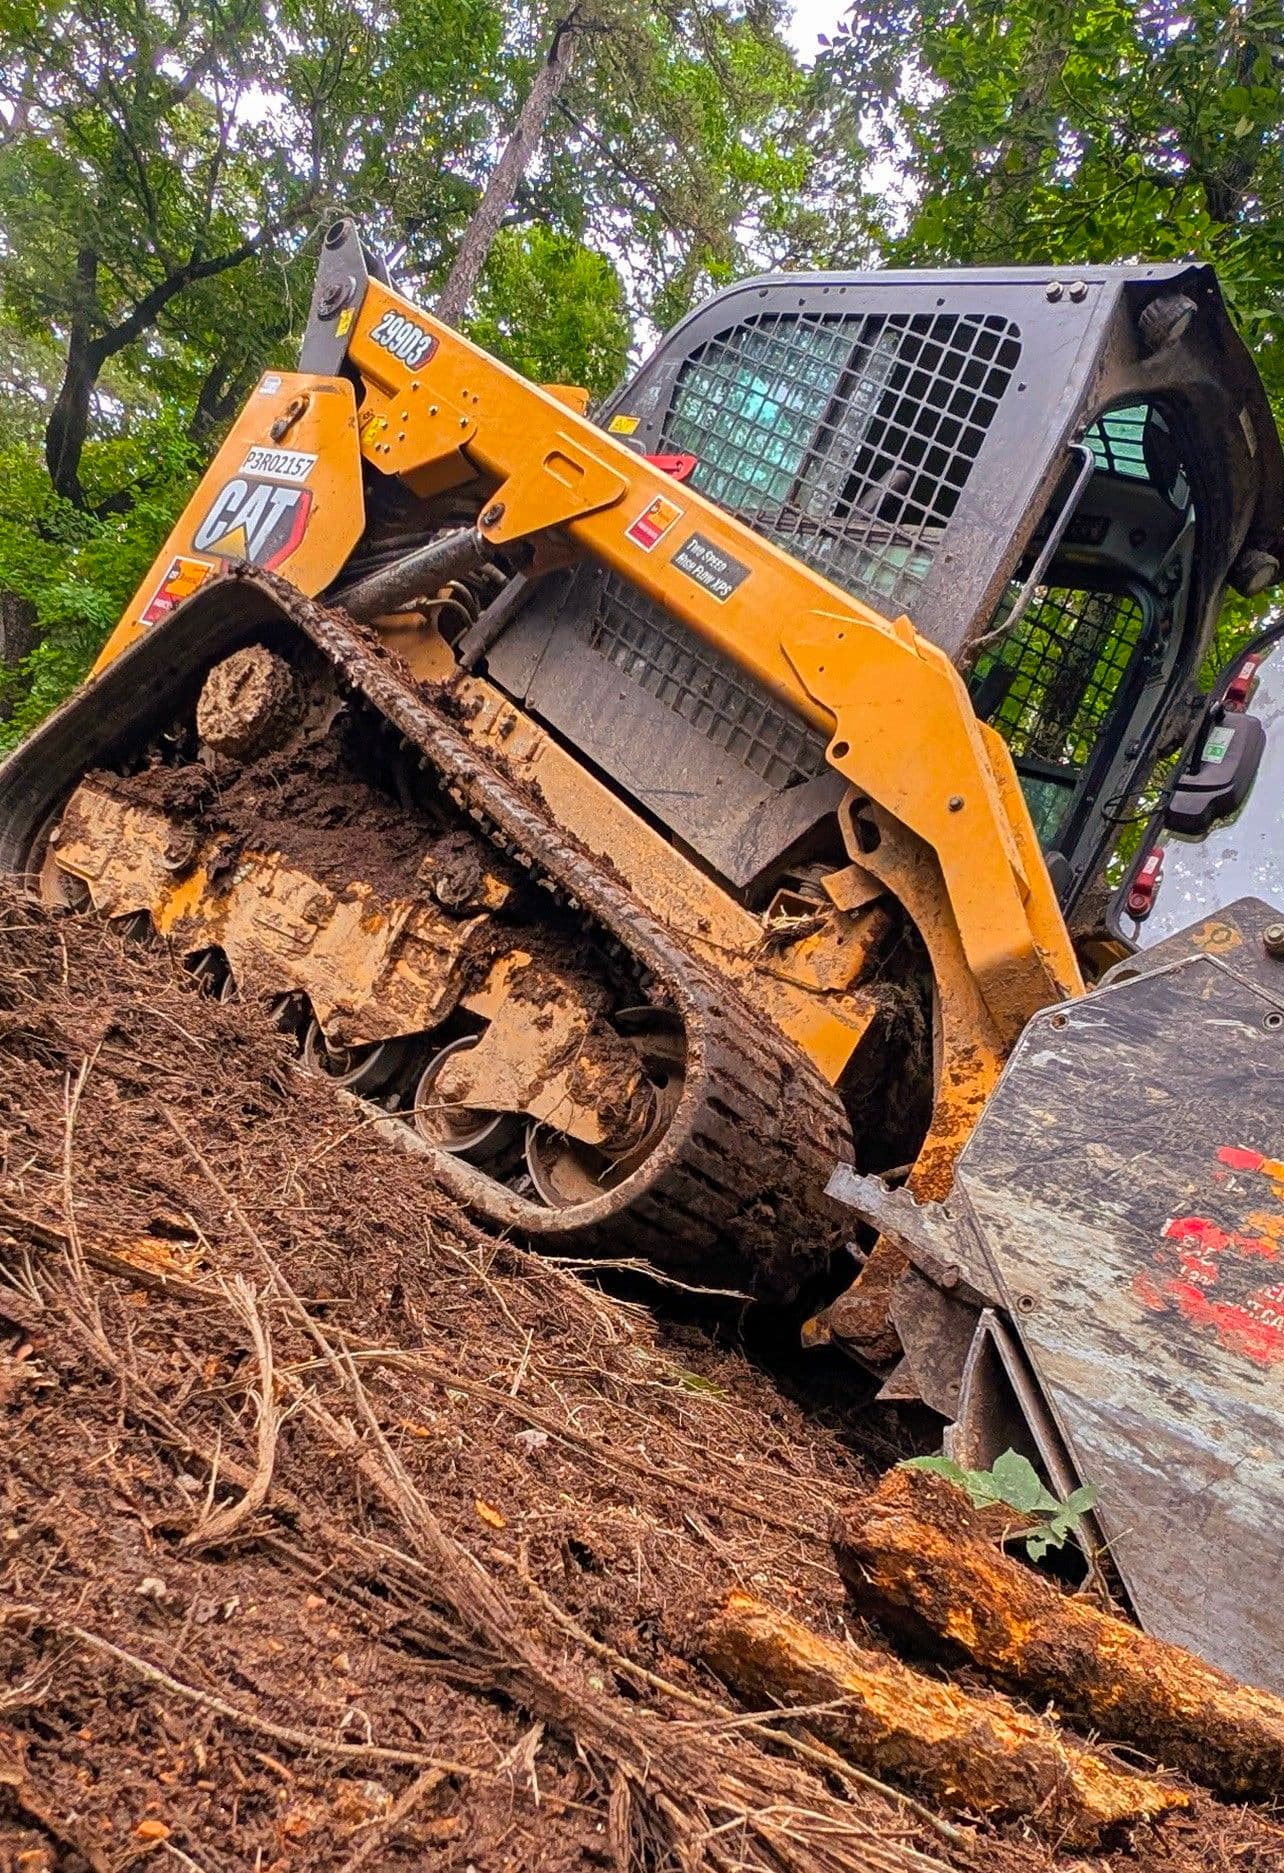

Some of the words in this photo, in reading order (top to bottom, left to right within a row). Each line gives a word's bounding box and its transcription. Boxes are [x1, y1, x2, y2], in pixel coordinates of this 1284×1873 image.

[370, 311, 432, 367] 299D3
[243, 451, 315, 477] P3R02157
[194, 479, 302, 562] CAT
[710, 577, 732, 596] XPS
